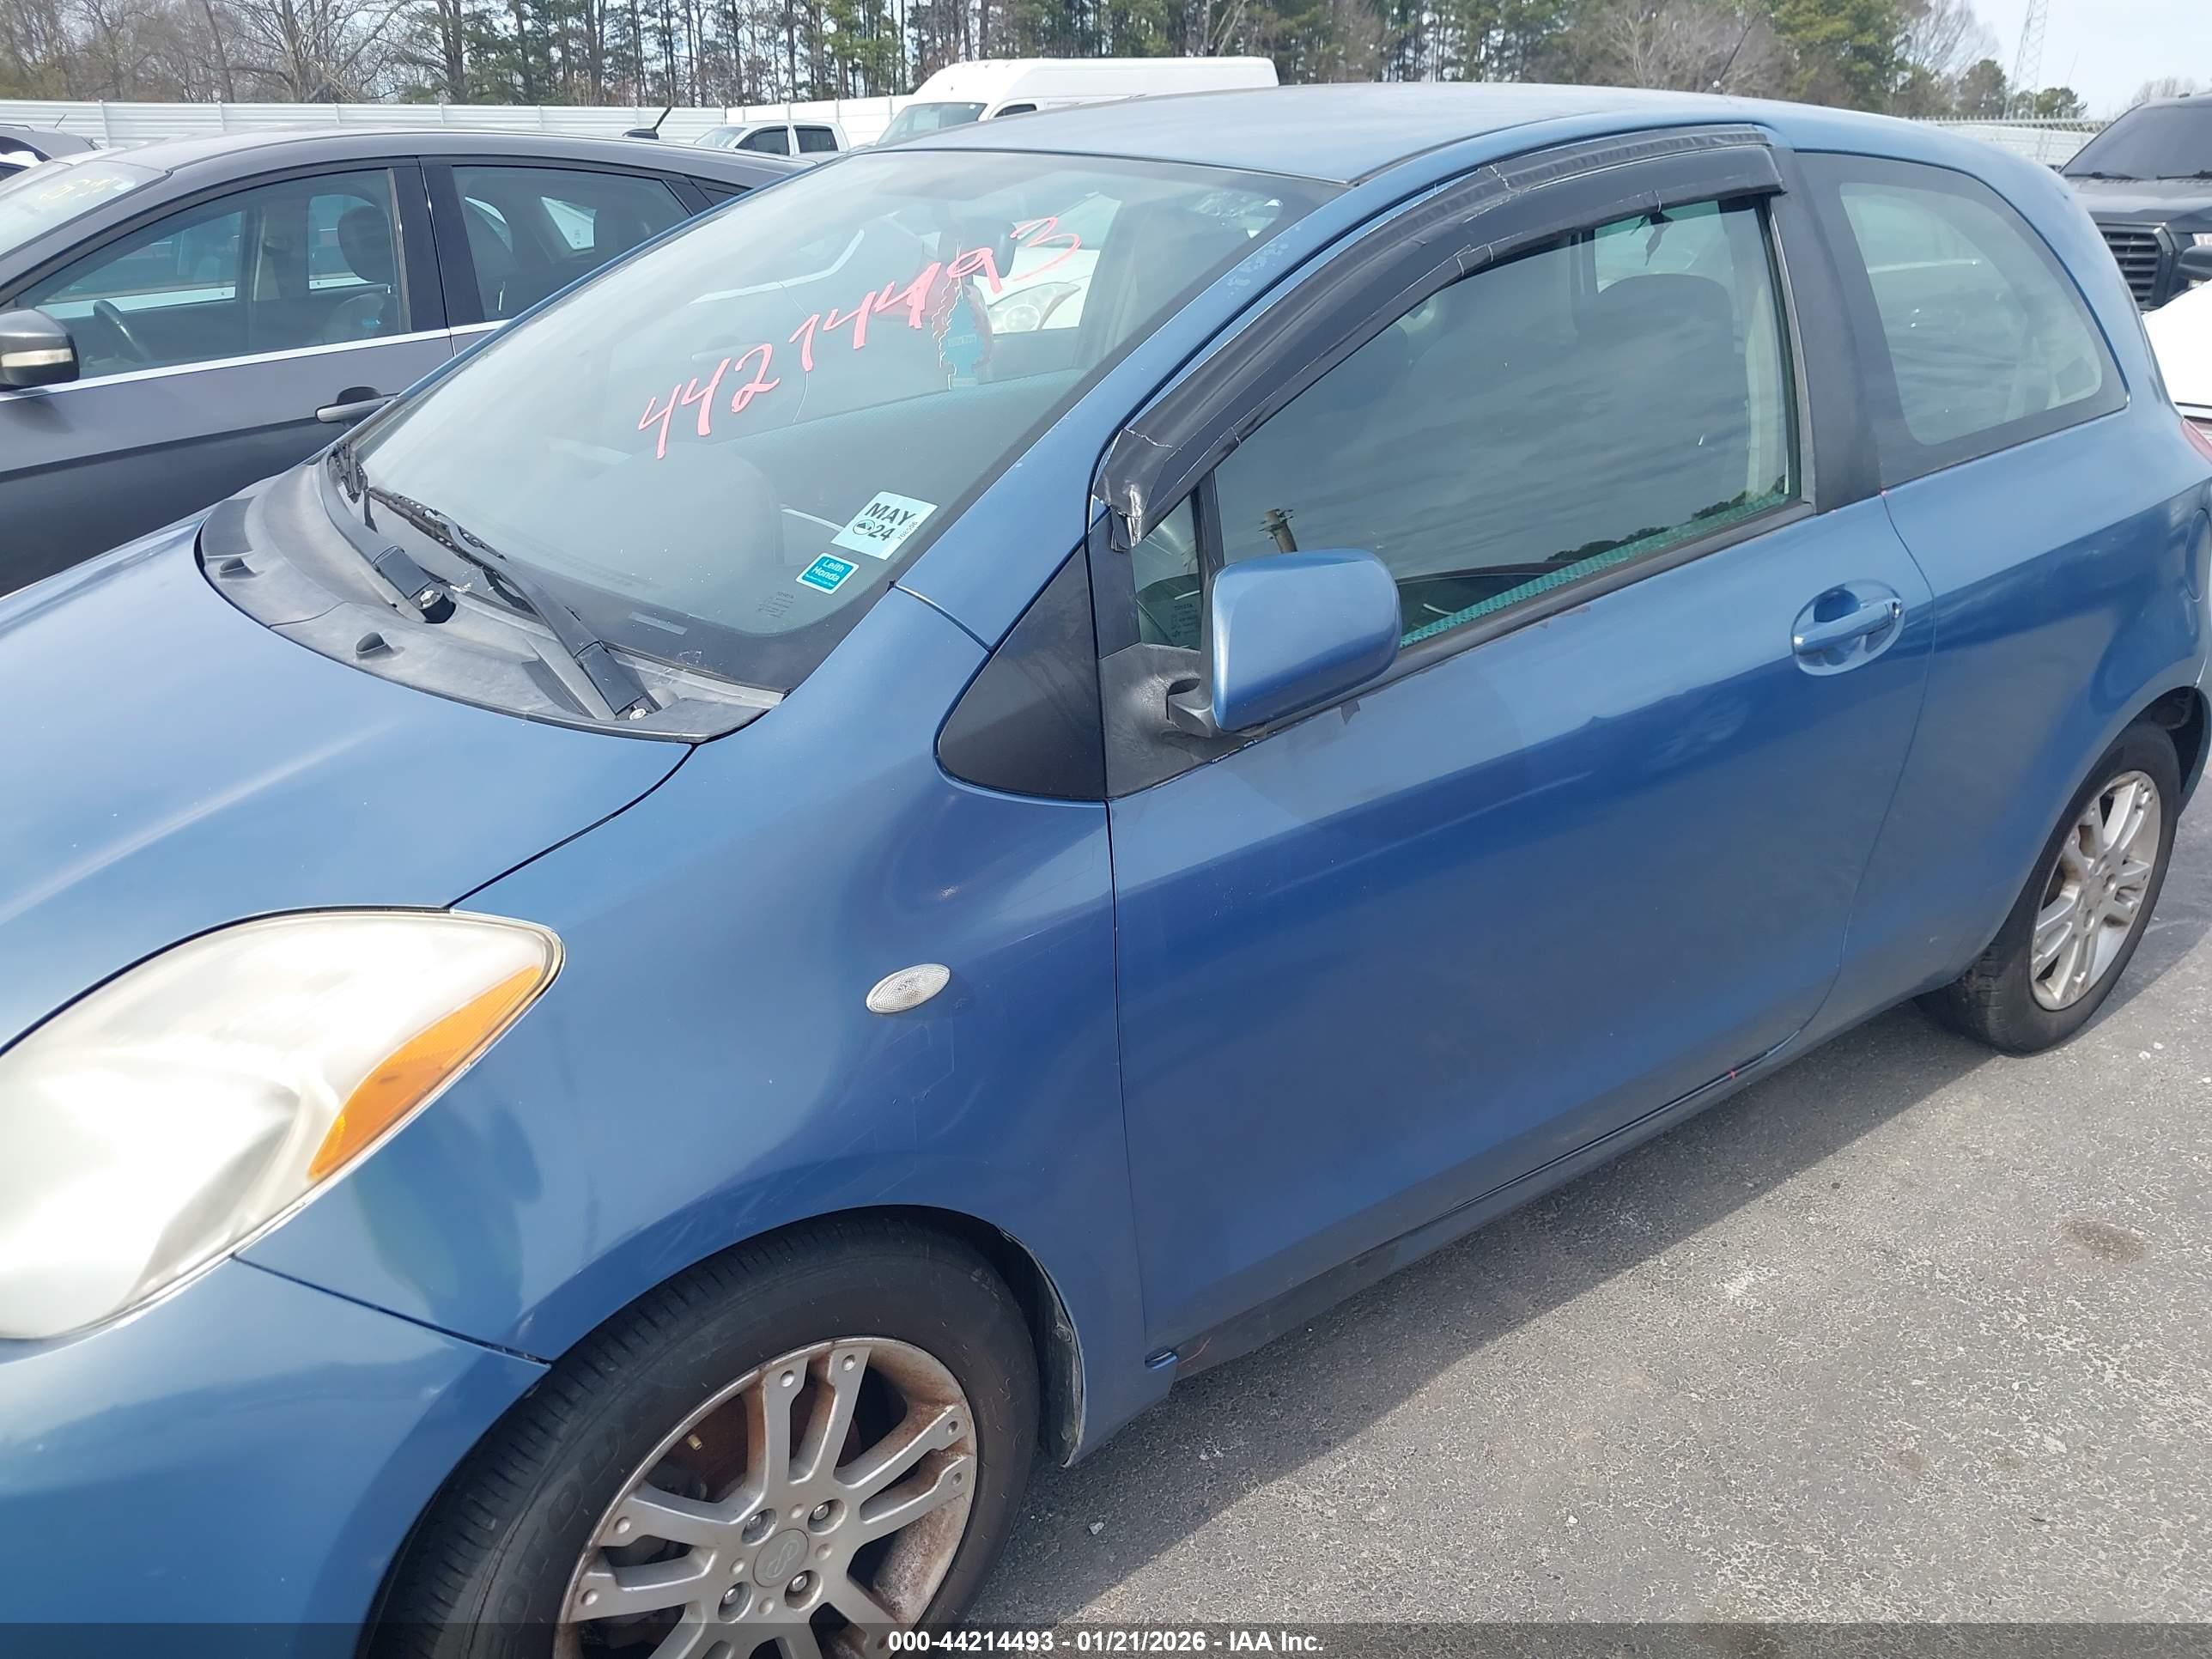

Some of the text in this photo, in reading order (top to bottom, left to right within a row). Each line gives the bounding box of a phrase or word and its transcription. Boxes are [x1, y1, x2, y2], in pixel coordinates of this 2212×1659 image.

[864, 502, 916, 526] MAY
[868, 525, 896, 541] 24
[811, 565, 841, 582] Honda
[822, 559, 845, 574] Leith
